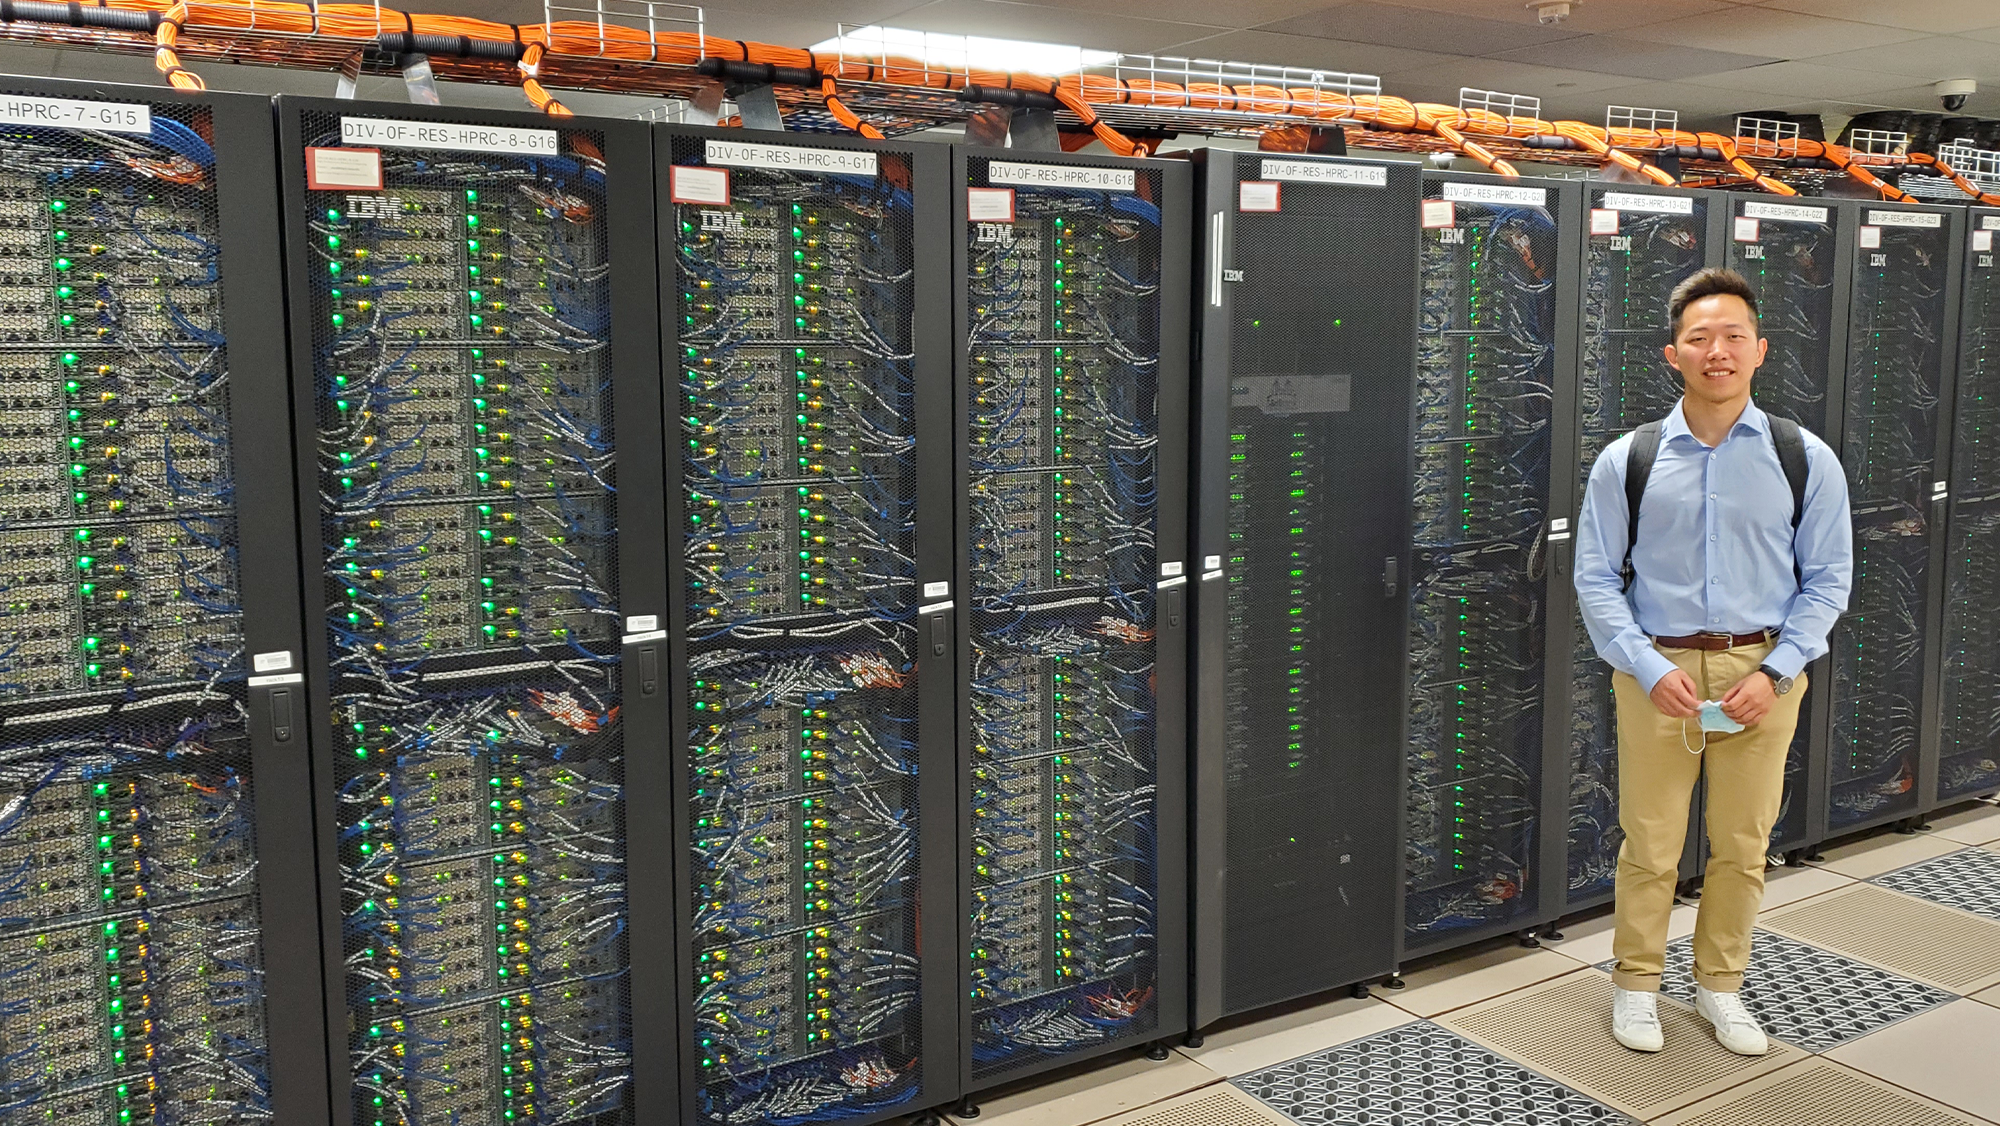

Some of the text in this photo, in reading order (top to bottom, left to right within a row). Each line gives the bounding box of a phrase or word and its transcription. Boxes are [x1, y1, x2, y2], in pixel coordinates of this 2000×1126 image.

[344, 123, 556, 150] DIV-OF-RES-HPRC-8-G16
[708, 145, 876, 170] DIV-OF-RES-HPRC-9-G17
[990, 166, 1134, 186] DIV-OF-RES-HPRC-10-G18
[1262, 164, 1386, 181] DIV-OF-RES-HPRC-11-G19
[1444, 186, 1545, 202] DIV-OF-RES-HPRC-12-G20
[346, 195, 401, 219] IBM
[700, 210, 744, 231] IBM
[977, 223, 1014, 242] IBM
[1440, 227, 1465, 244] IBM
[1610, 235, 1632, 251] IBM
[1745, 245, 1764, 259] IBM
[1870, 253, 1886, 267] IBM
[1223, 269, 1244, 281] IBM
